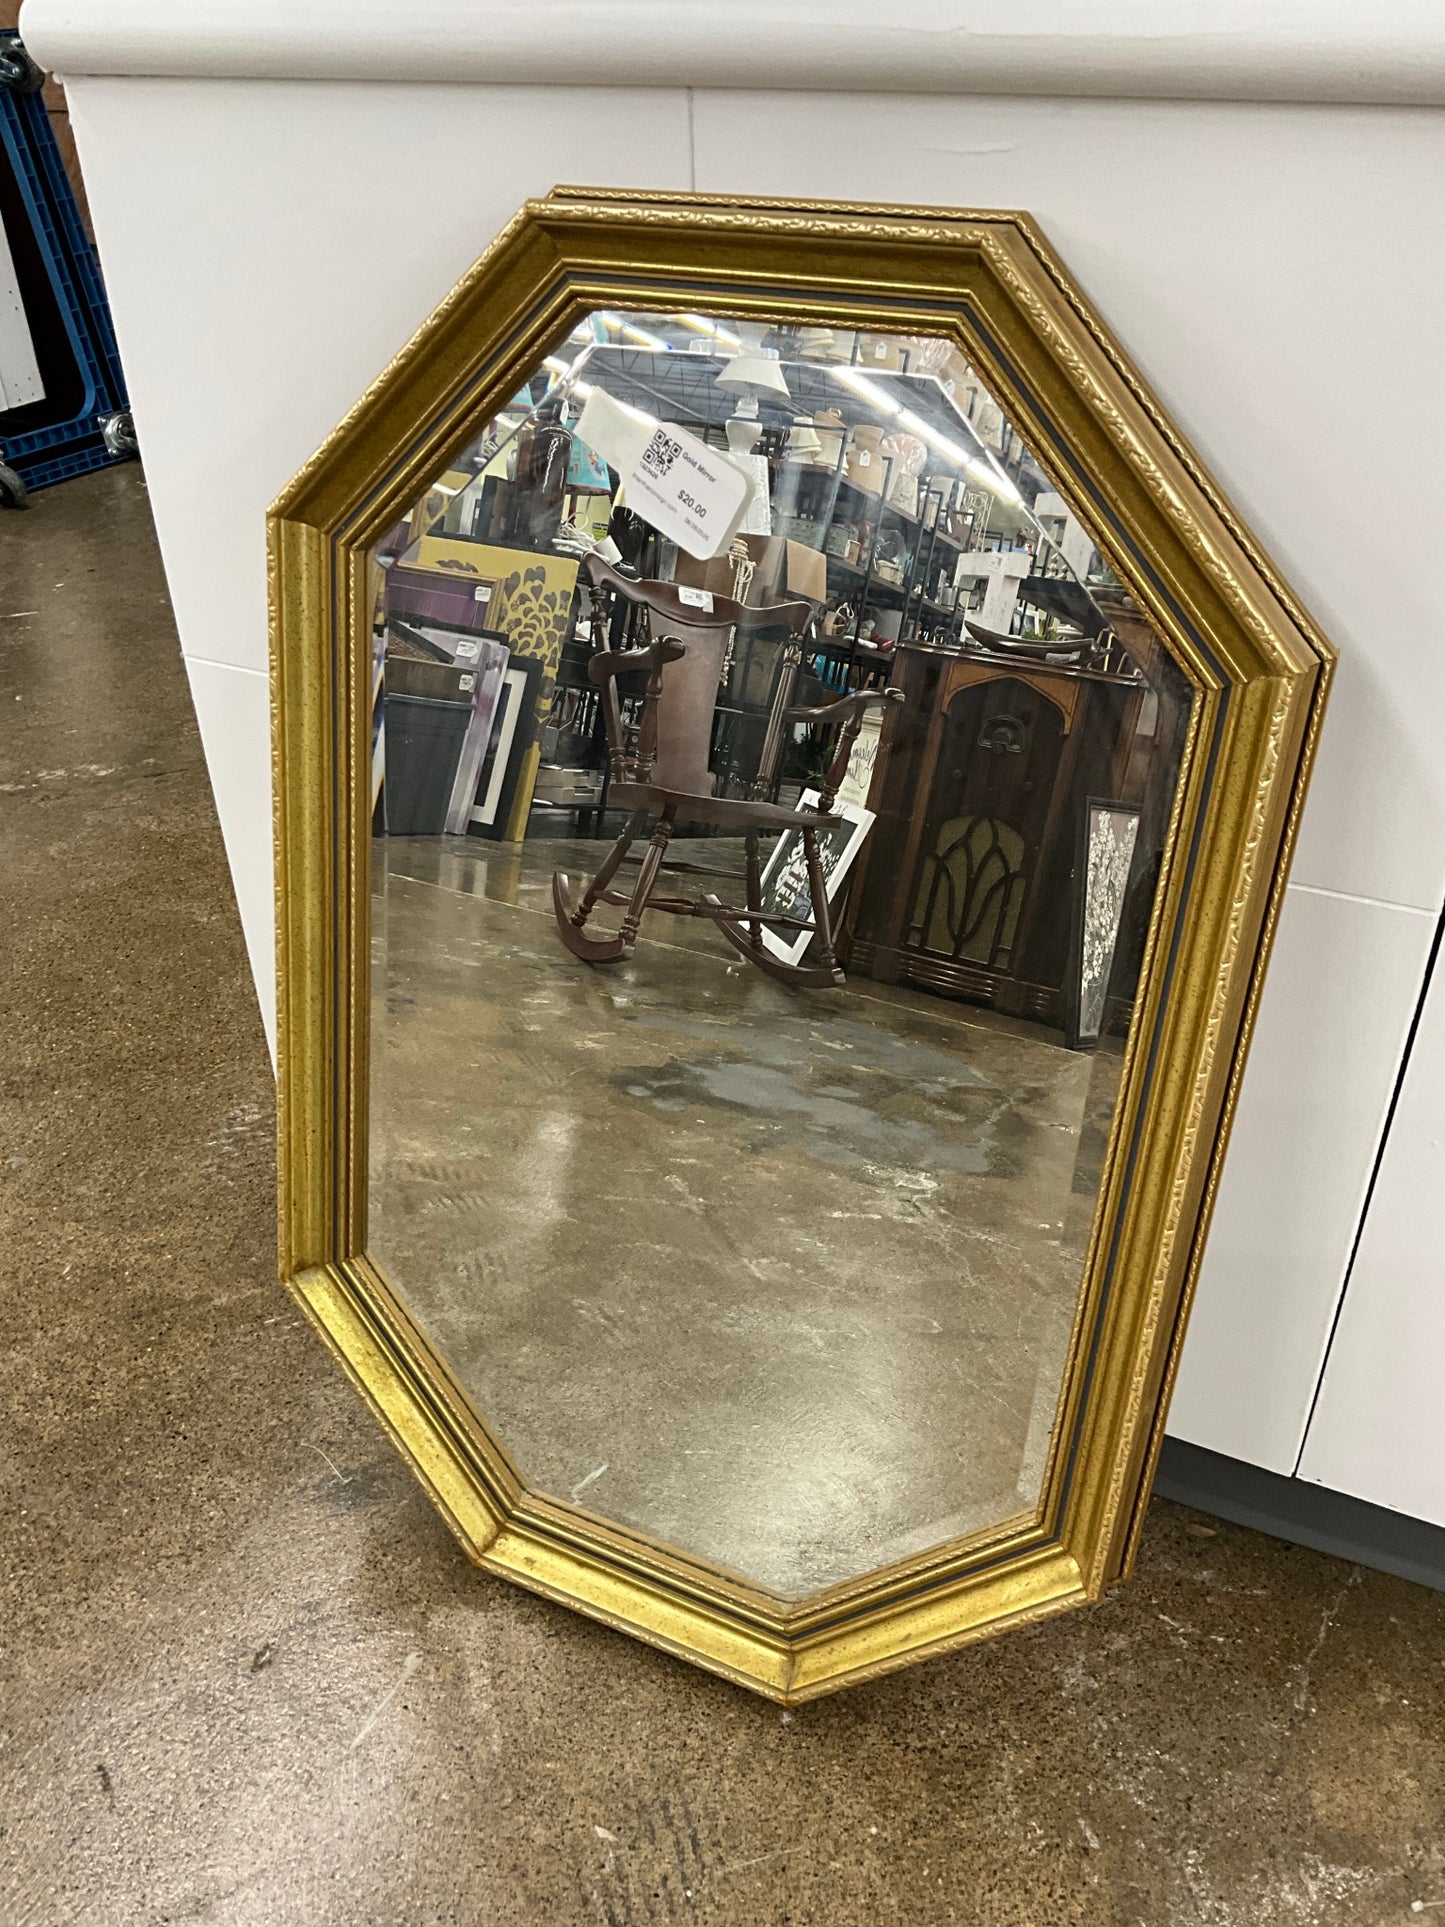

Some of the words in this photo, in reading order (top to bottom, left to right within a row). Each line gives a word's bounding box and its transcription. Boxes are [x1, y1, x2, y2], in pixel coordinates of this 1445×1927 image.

[682, 452, 698, 468] Gold
[697, 464, 716, 483] Mirror
[677, 489, 707, 518] $20.00
